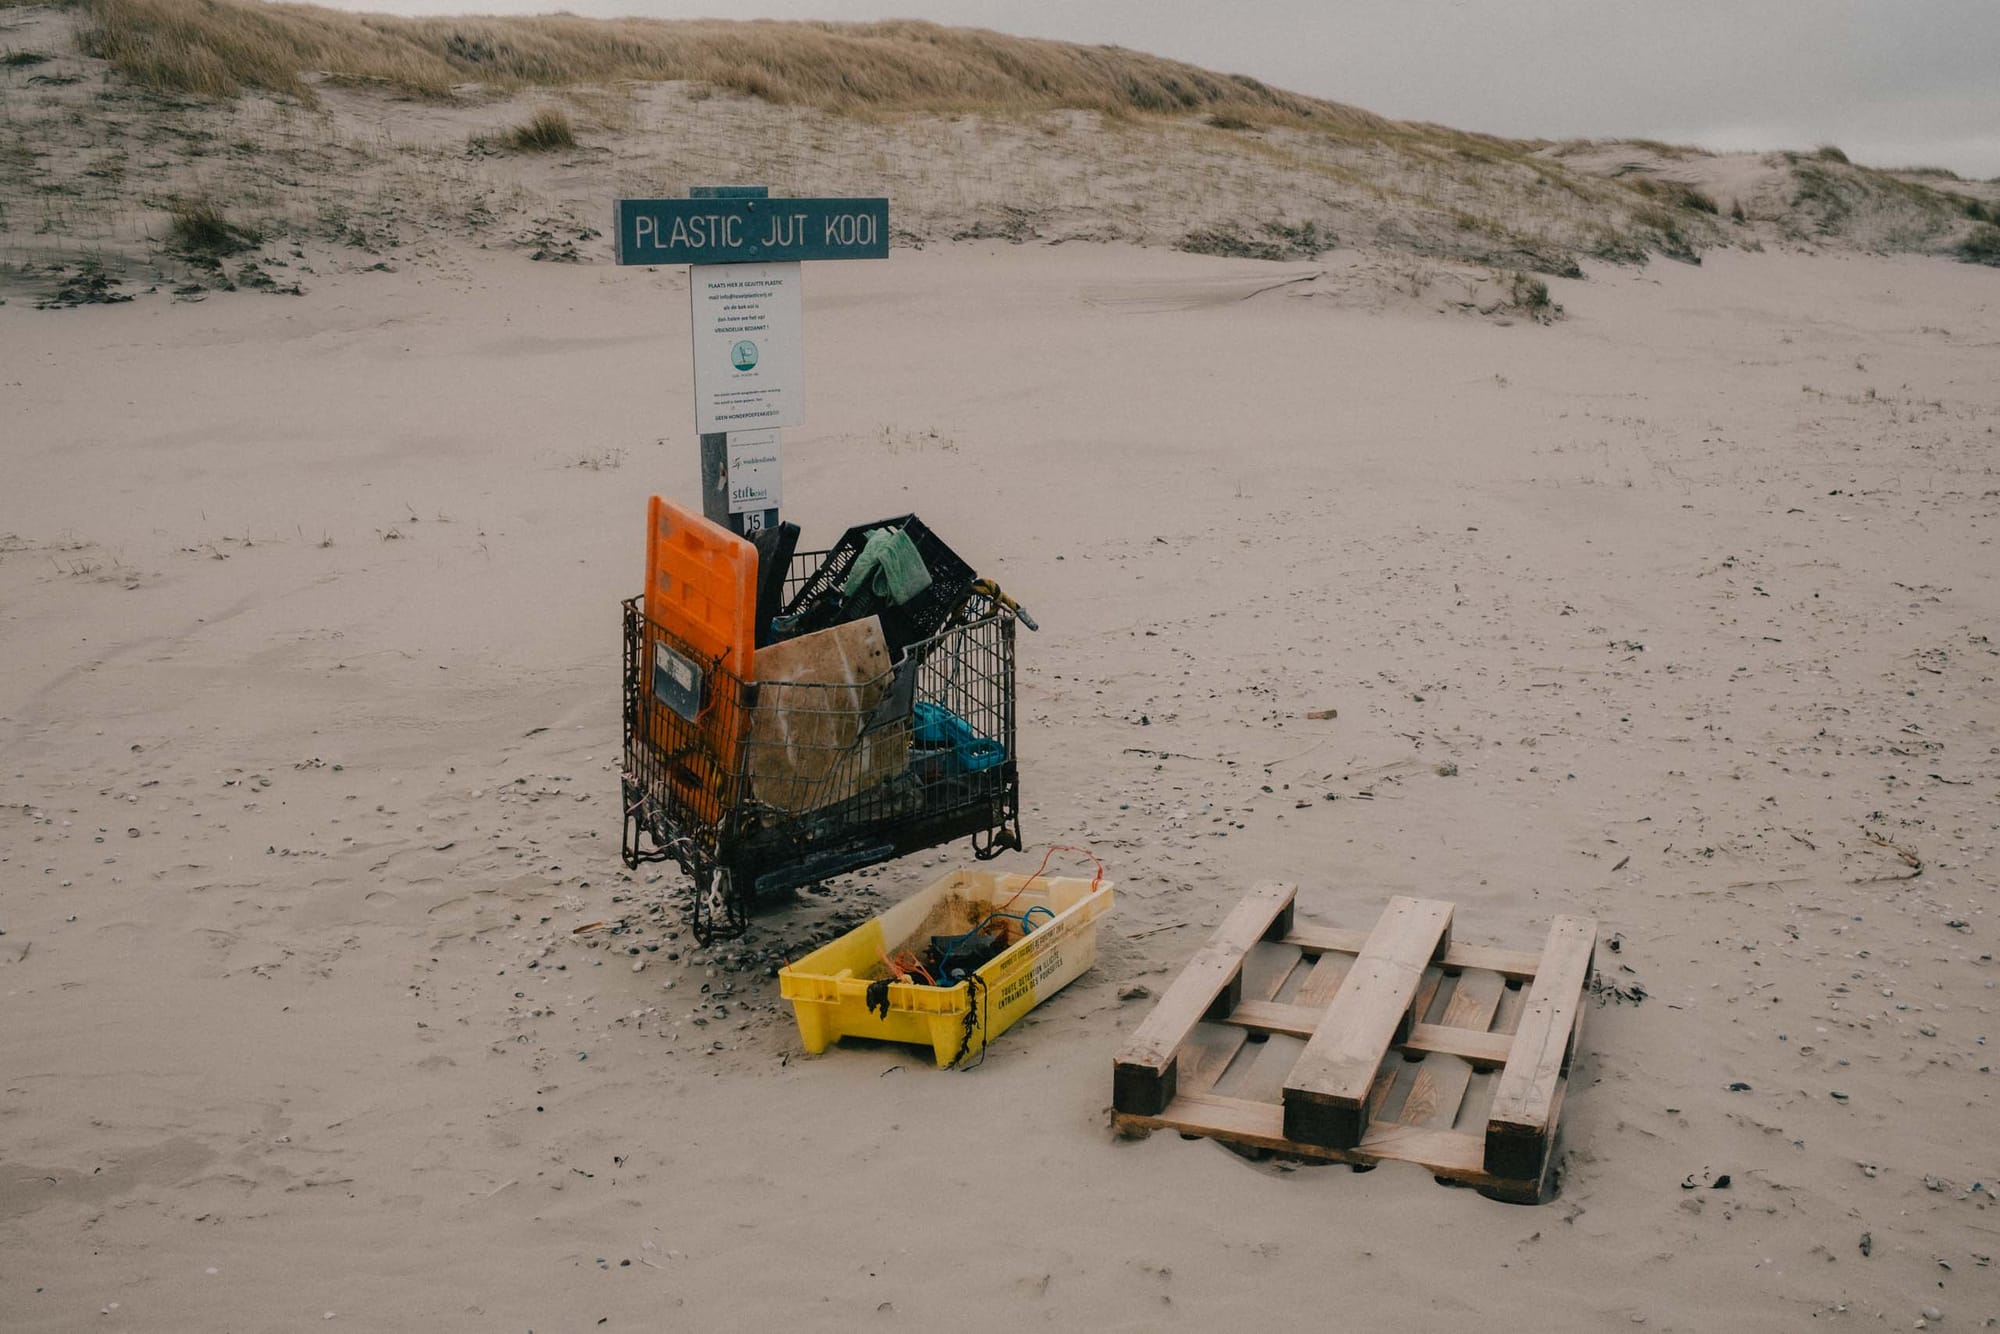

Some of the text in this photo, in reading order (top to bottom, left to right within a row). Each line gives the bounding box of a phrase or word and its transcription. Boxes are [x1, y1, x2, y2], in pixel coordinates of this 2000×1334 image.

[636, 213, 876, 248] PLASTIC JUT KOOI
[715, 413, 728, 421] GEEN
[748, 514, 761, 530] 15
[1001, 982, 1017, 998] TOUTE
